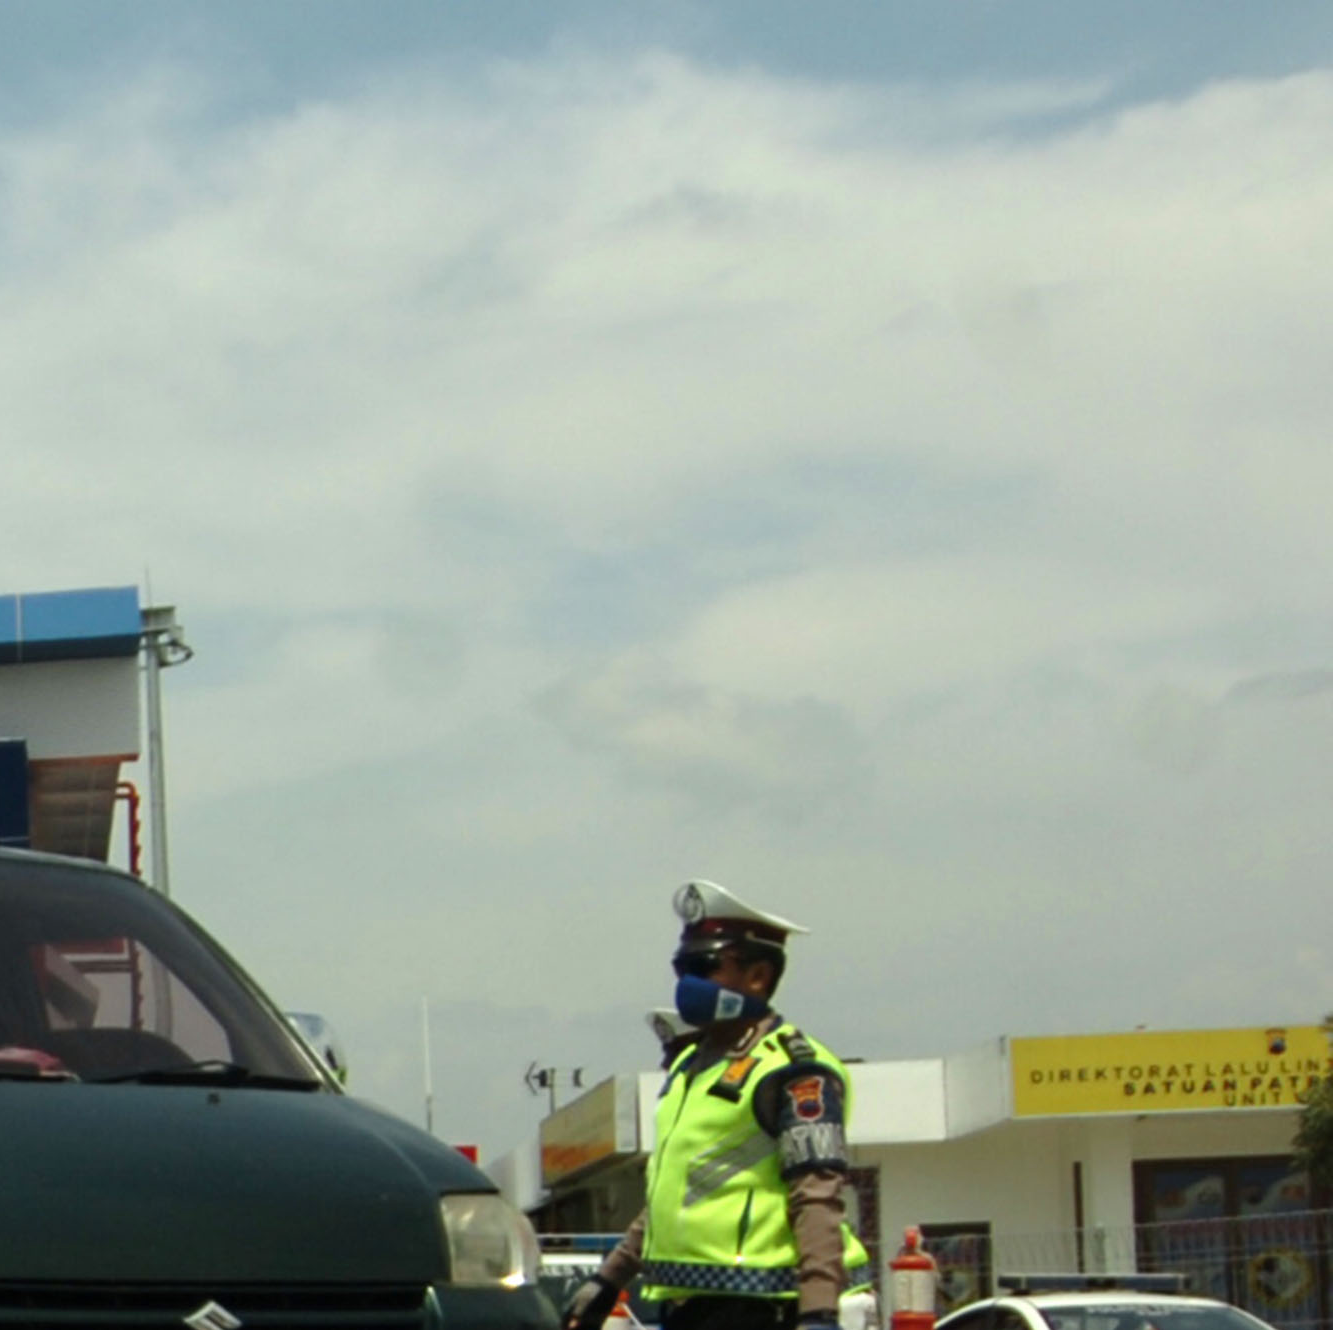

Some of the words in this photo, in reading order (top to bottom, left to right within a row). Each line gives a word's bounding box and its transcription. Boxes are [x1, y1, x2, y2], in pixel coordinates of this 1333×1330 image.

[1030, 1063, 1195, 1085] DIREKTORAT
[1205, 1060, 1270, 1077] LALU
[1123, 1078, 1238, 1097] SATUAN
[1224, 1090, 1281, 1107] UNIT
